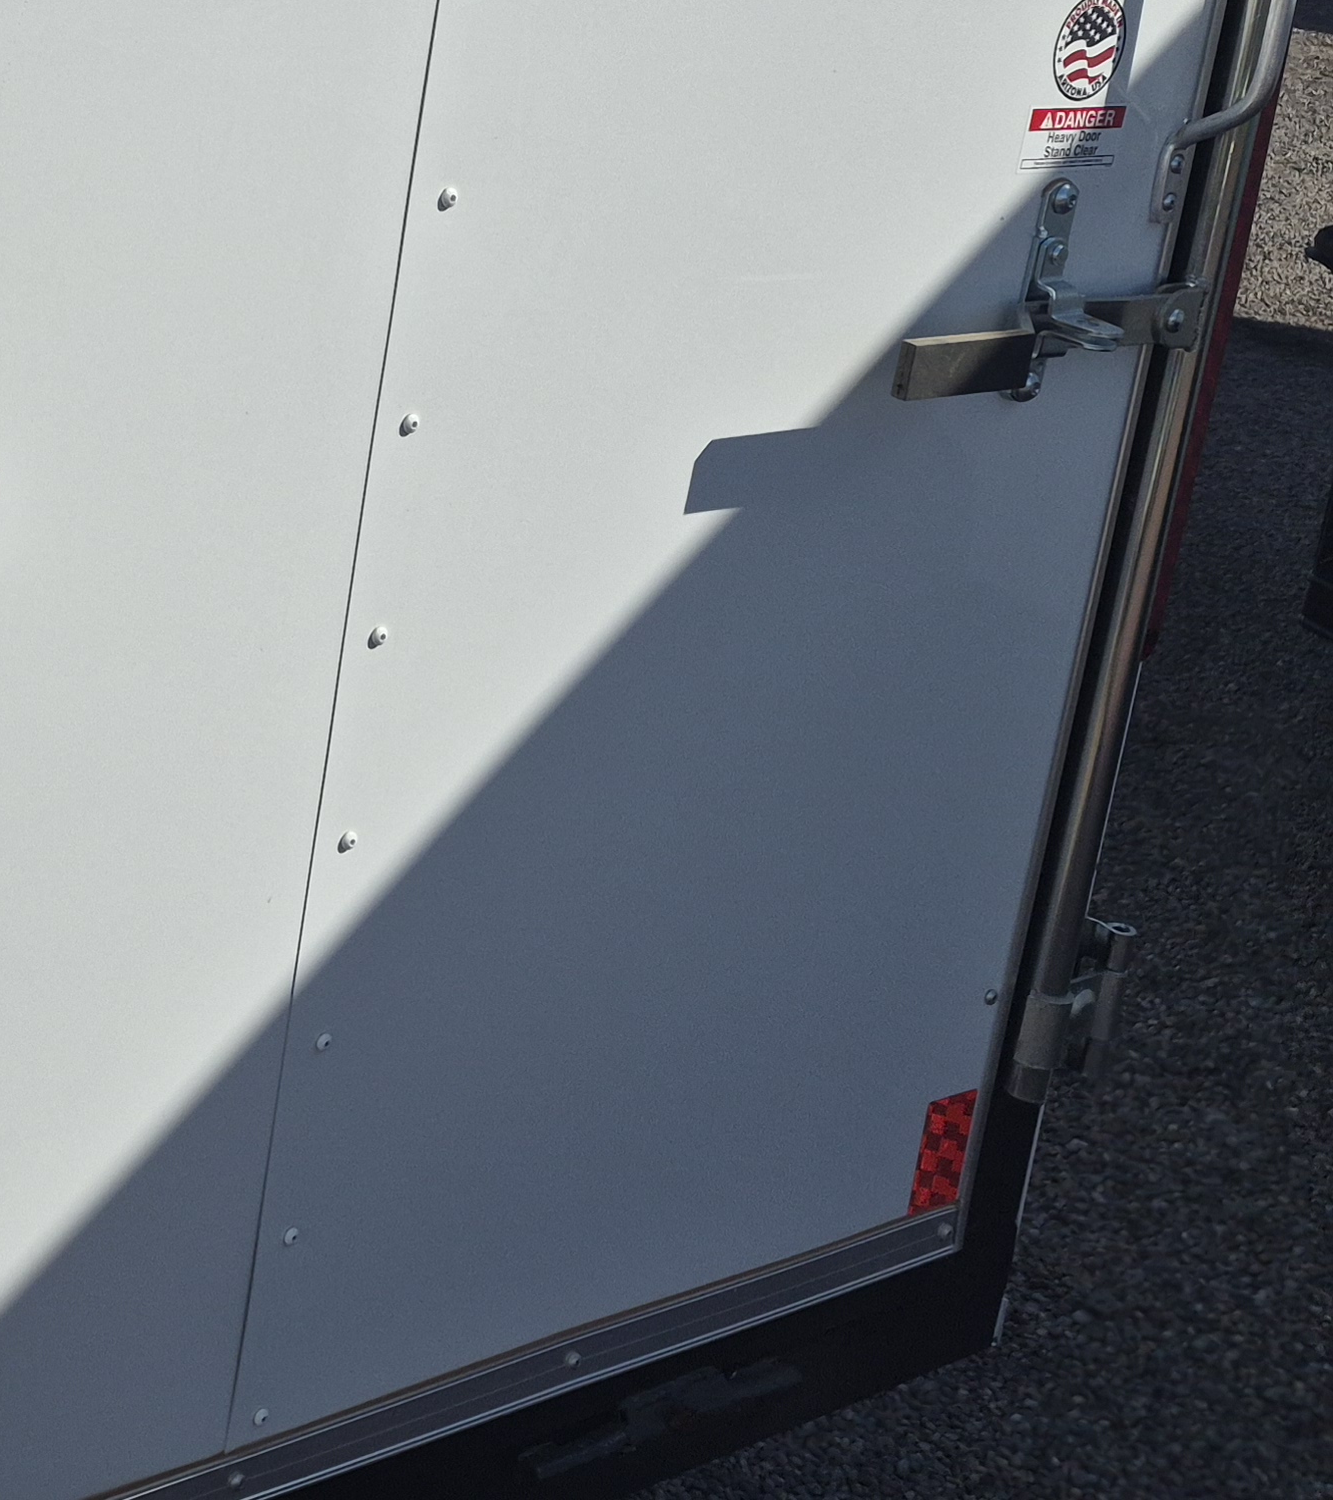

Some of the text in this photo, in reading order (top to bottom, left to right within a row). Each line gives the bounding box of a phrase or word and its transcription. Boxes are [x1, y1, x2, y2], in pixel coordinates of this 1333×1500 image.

[1116, 15, 1123, 28] IN
[1091, 74, 1107, 92] USA
[1053, 110, 1115, 128] DANGER
[1047, 130, 1102, 144] Heavy Door
[1044, 144, 1098, 157] Stand Clear
